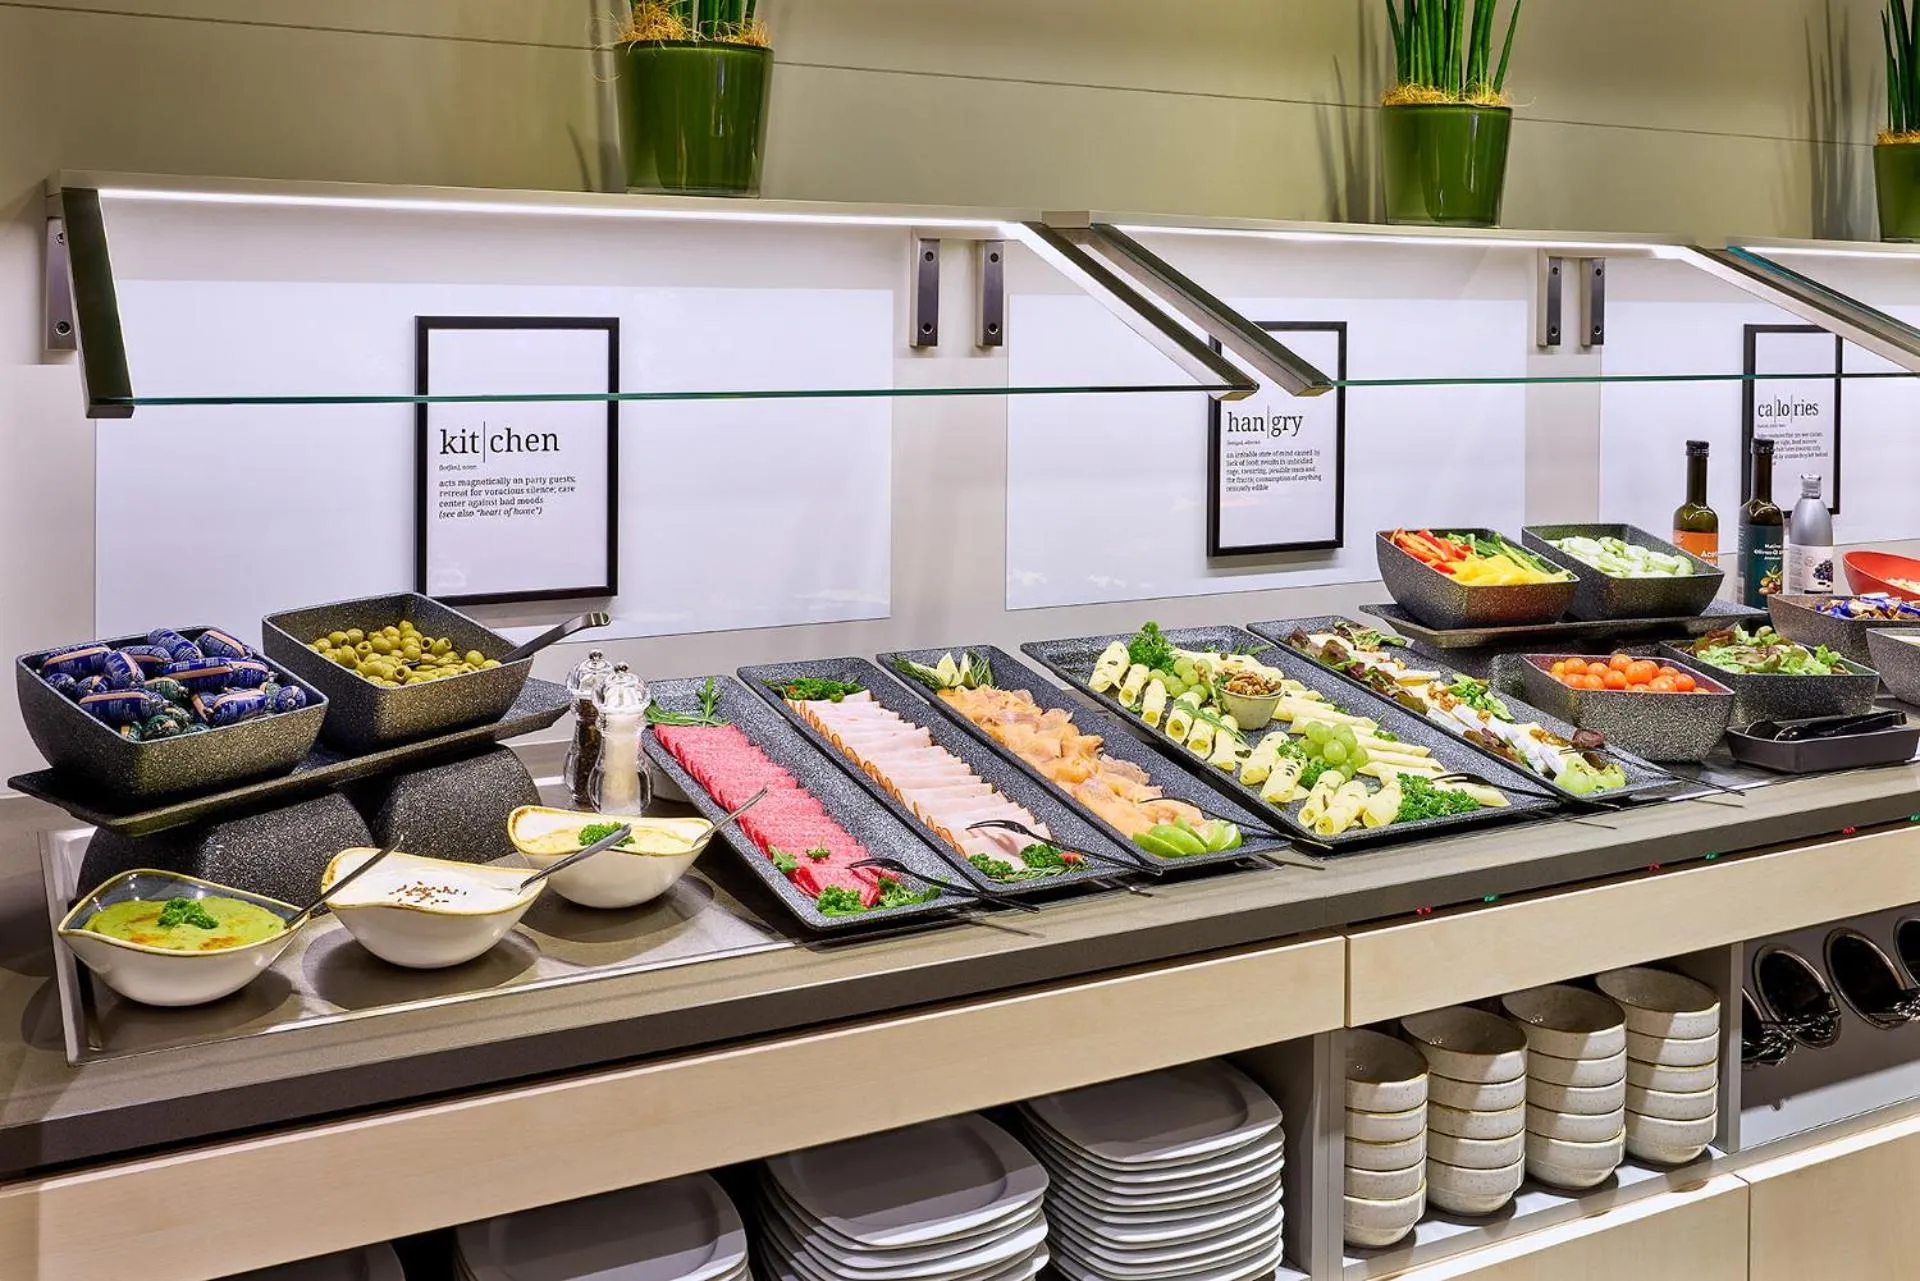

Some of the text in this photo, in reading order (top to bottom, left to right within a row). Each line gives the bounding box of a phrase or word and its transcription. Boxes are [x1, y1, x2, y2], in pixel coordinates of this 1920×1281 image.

[458, 476, 511, 488] magnetically
[525, 477, 547, 486] party
[470, 488, 482, 496] for
[499, 497, 515, 505] bad
[456, 508, 475, 518] also
